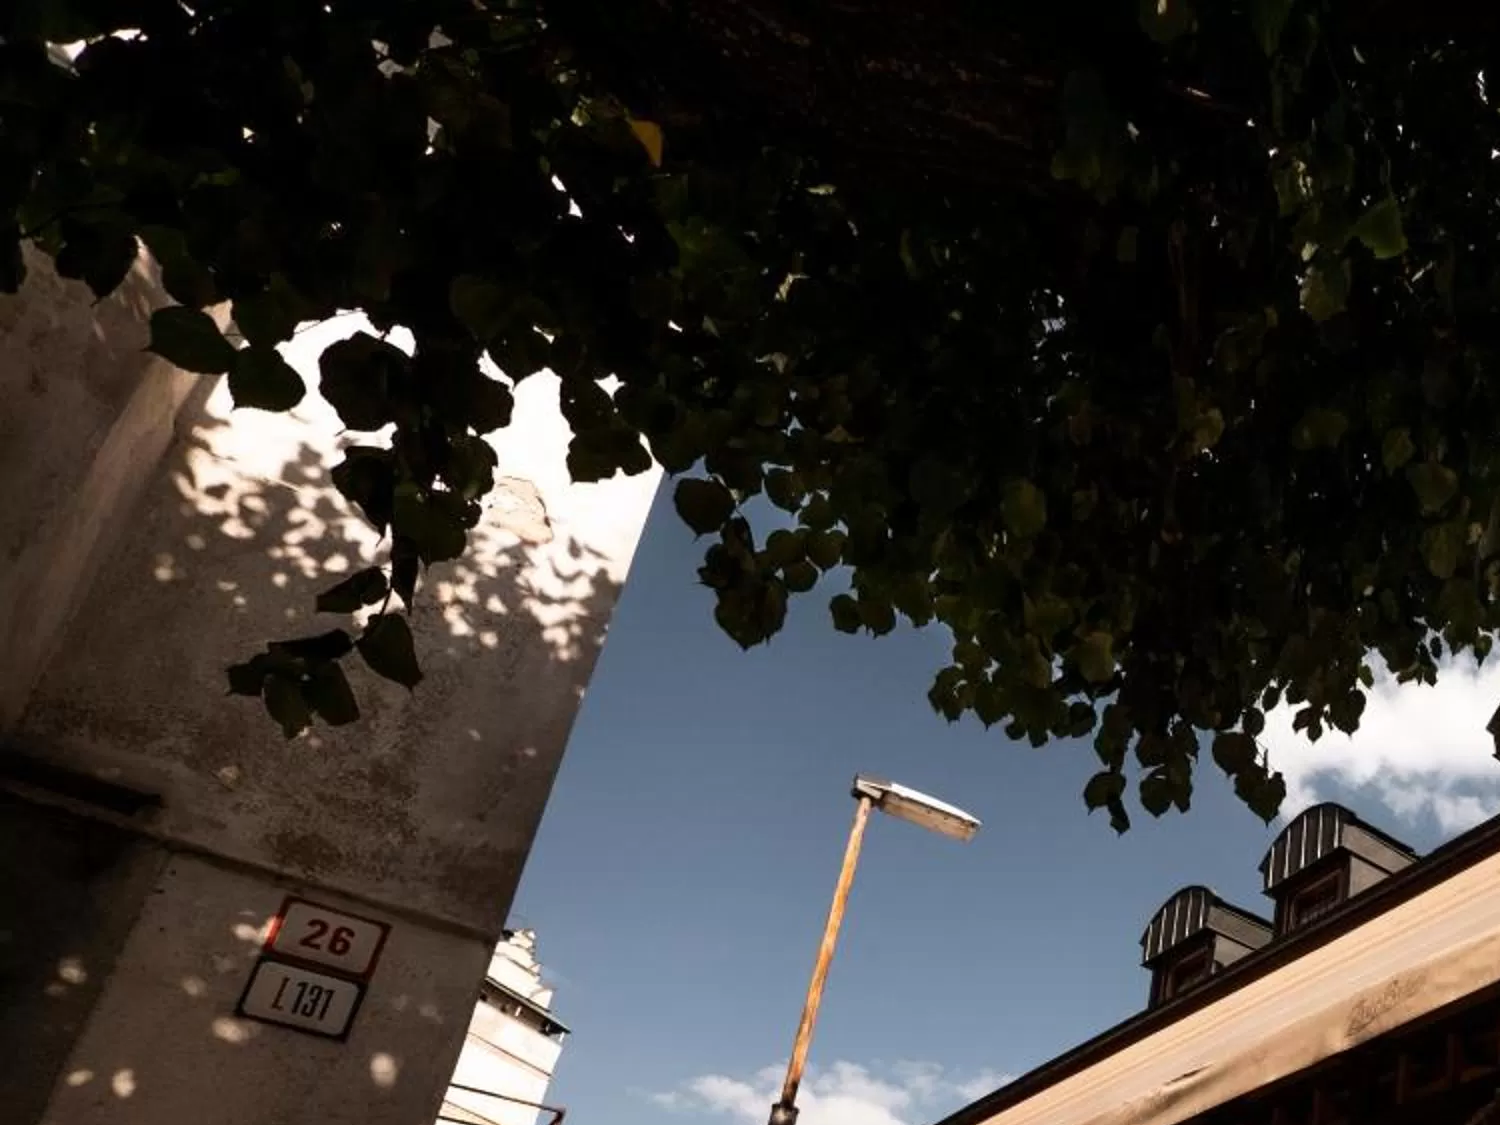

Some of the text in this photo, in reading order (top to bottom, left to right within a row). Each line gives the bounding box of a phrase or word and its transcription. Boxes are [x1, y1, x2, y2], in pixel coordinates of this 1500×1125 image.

[300, 918, 356, 956] 26
[271, 976, 336, 1022] L 131
